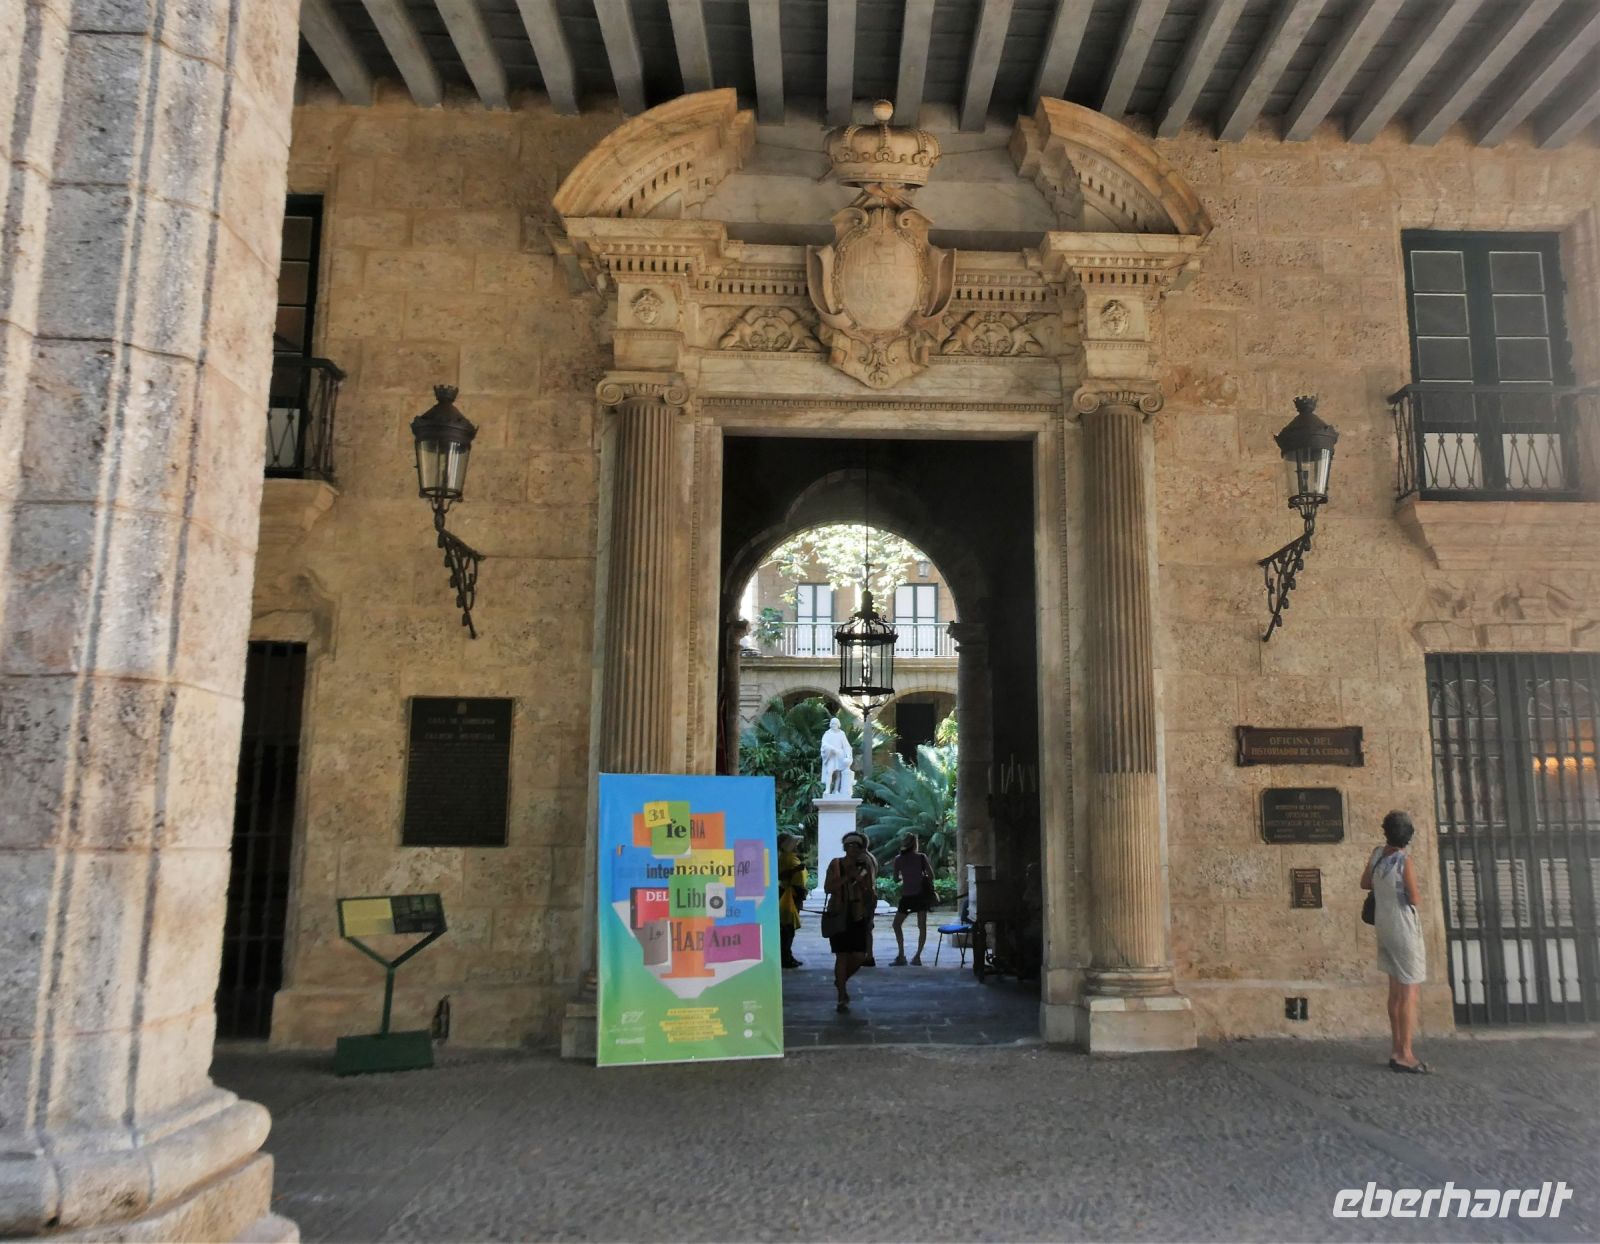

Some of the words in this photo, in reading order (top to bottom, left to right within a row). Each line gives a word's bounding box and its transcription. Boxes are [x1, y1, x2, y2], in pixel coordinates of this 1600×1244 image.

[1269, 736, 1310, 745] OFICINA
[1313, 736, 1332, 745] DEL
[1299, 747, 1309, 756] DE
[1310, 747, 1320, 756] LA
[645, 890, 669, 902] DEL
